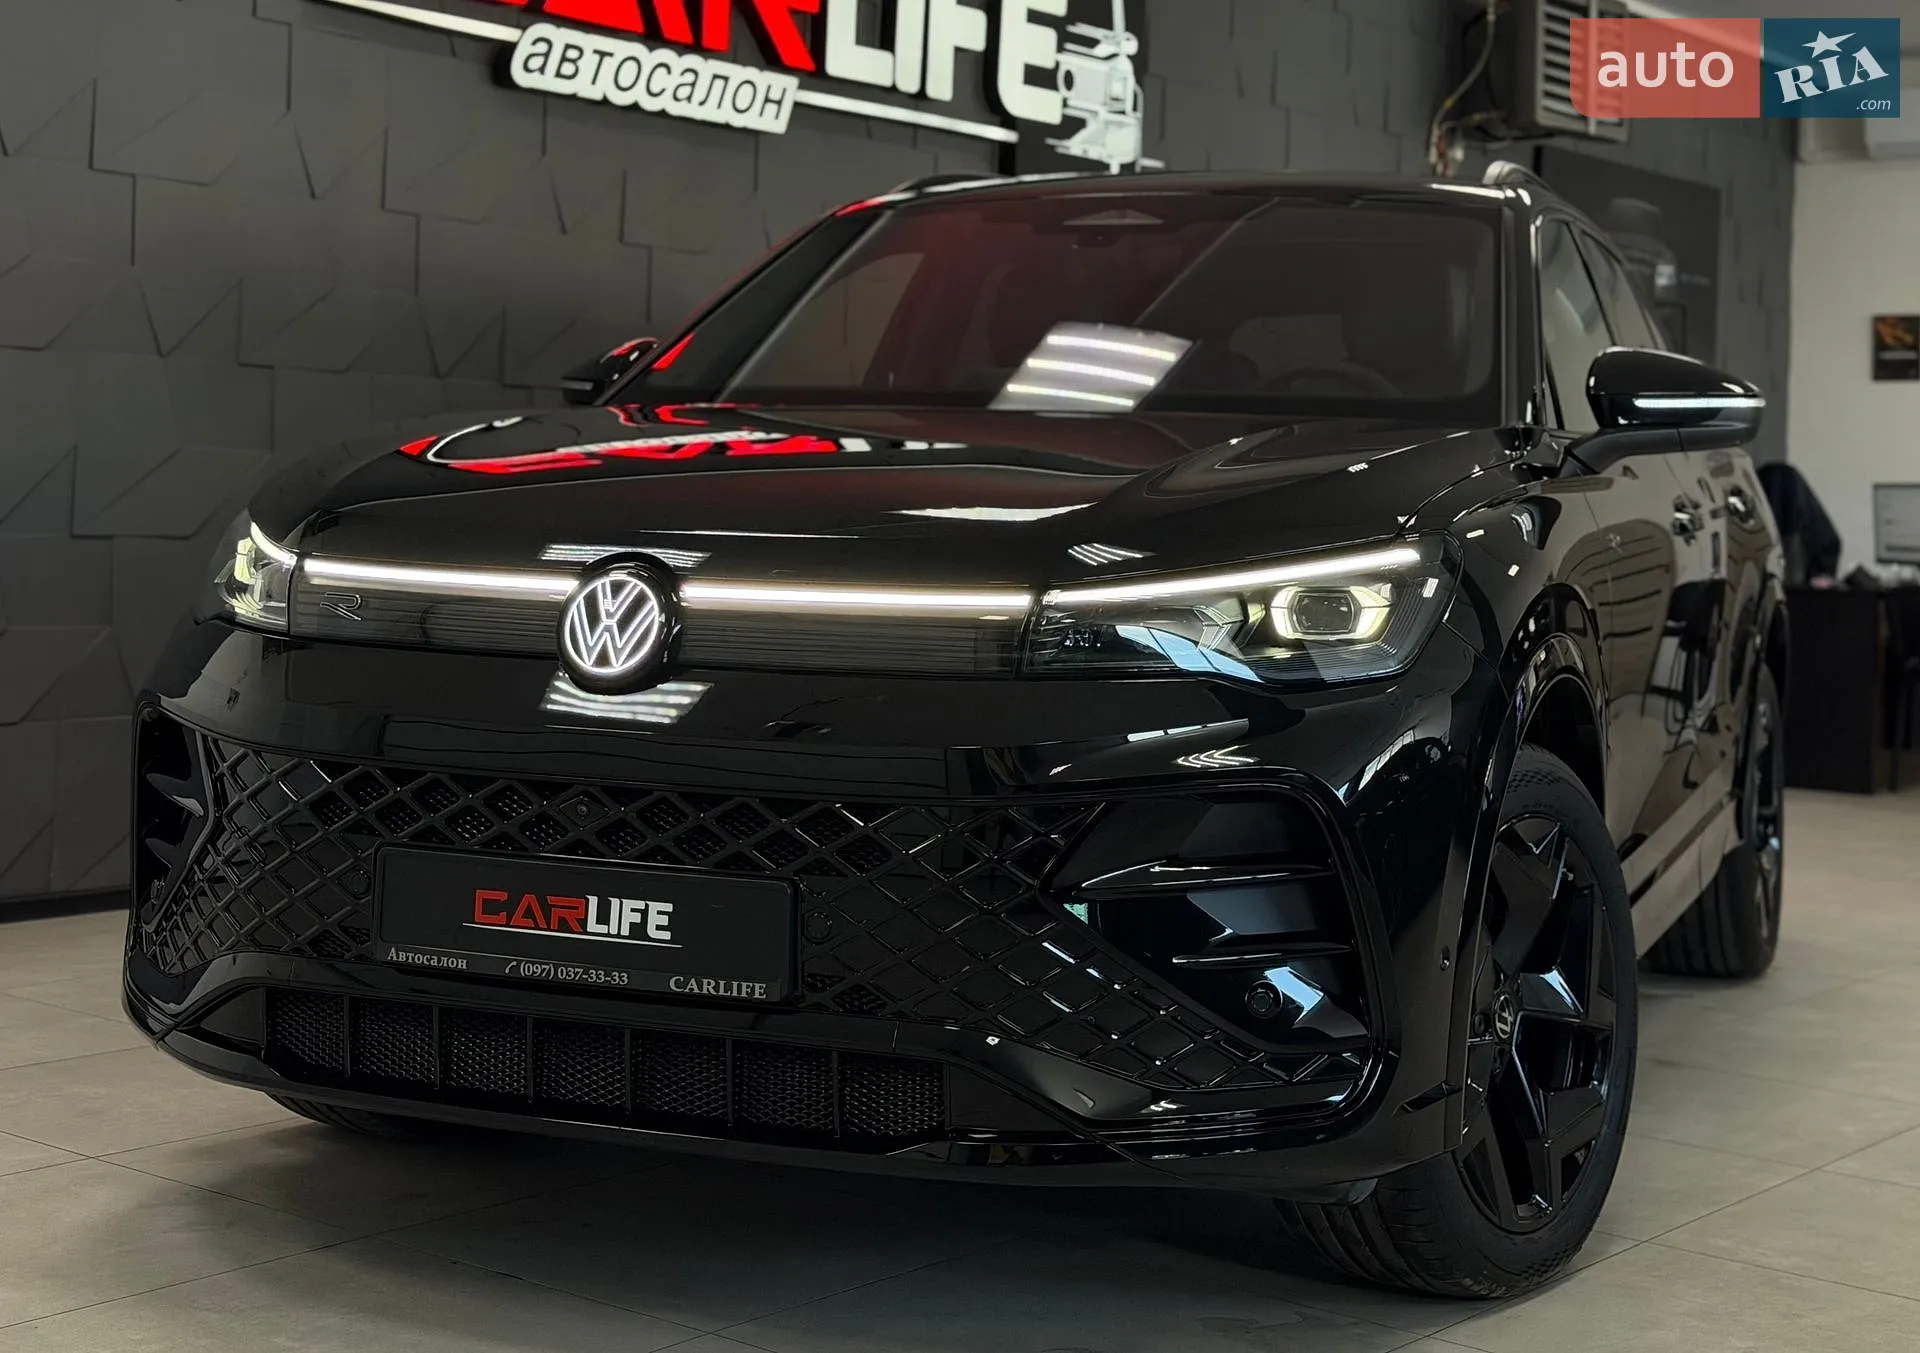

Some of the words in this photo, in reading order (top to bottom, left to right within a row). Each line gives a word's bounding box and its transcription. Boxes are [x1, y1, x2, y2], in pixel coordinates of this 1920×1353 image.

[522, 36, 789, 121] автосалон
[474, 889, 674, 940] CARLIFE
[387, 947, 468, 970] Автосалон
[520, 960, 555, 981] (097)
[557, 964, 629, 985] 037-33-33
[669, 975, 767, 1000] CARLIFE
